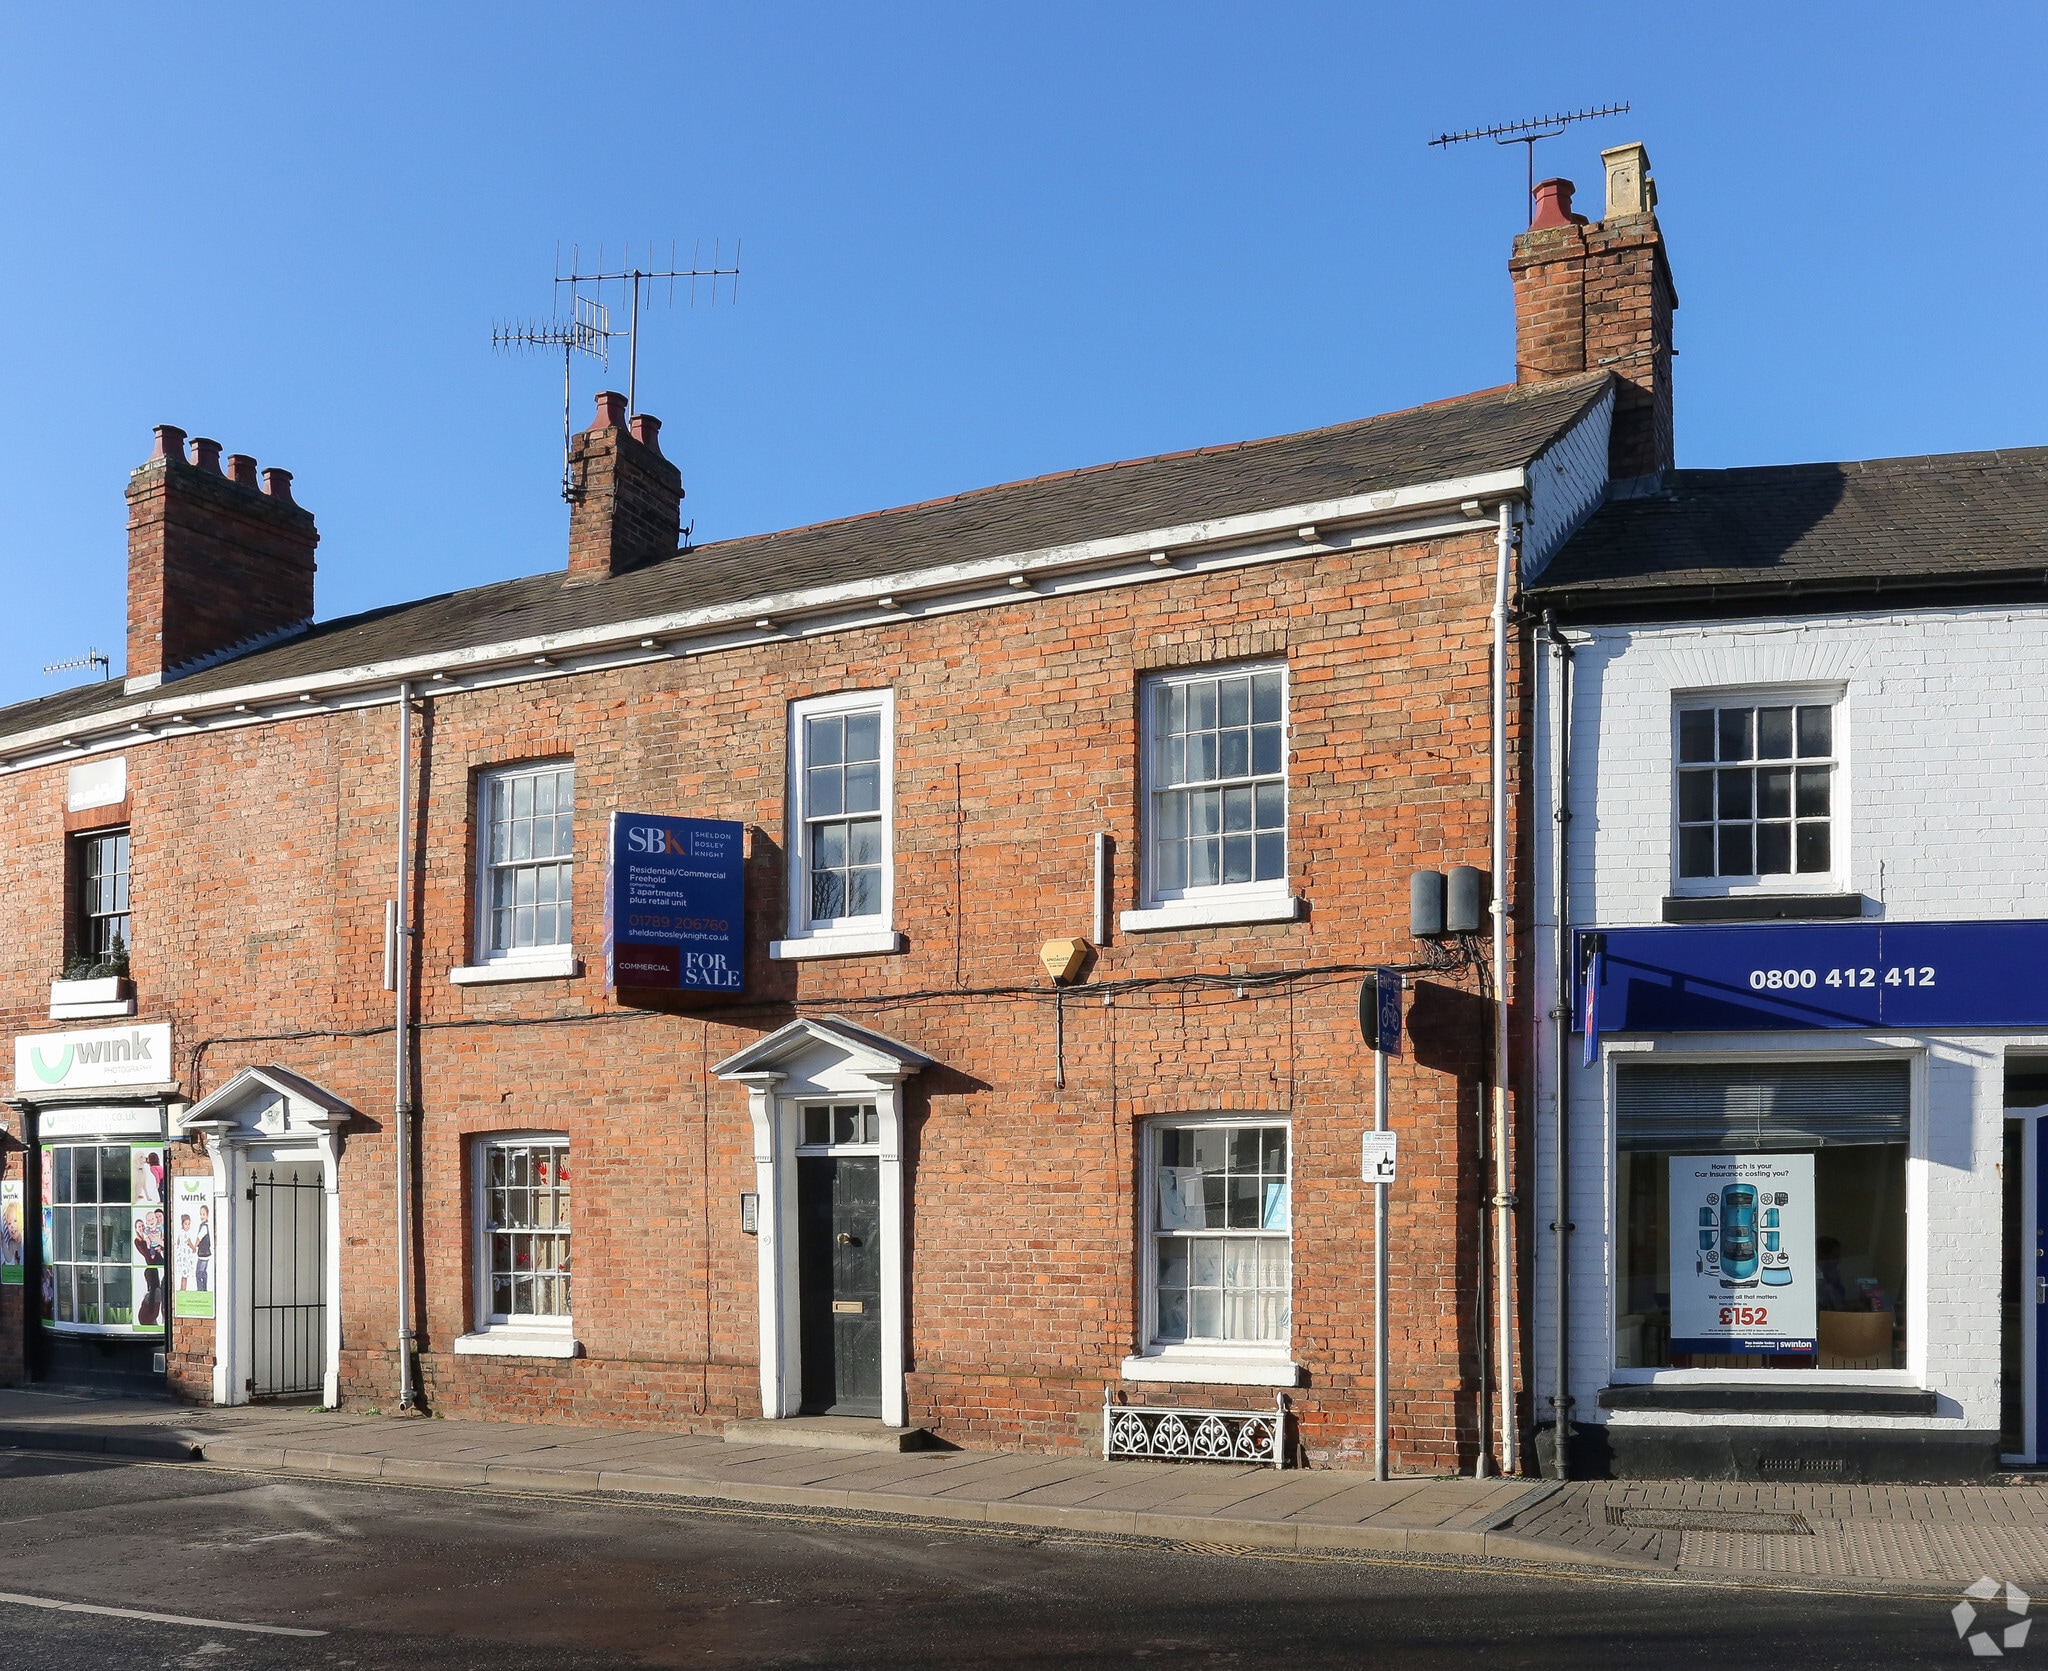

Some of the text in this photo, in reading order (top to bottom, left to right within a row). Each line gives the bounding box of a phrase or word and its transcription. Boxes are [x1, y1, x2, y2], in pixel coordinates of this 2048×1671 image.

[695, 831, 731, 840] SHELDON
[628, 827, 686, 855] SBK
[694, 841, 724, 849] BOSLEY
[630, 866, 726, 880] Residential/Commercial
[630, 875, 666, 884] Freehold
[637, 889, 684, 898] apartments
[630, 897, 687, 907] plus retail unit
[629, 914, 729, 932] 01789 206760
[628, 929, 729, 942] sheldonbosleyknight.co.uk
[685, 952, 727, 970] FOR
[619, 962, 670, 972] COMMERCIAL
[685, 968, 740, 987] SALE
[1749, 967, 1936, 989] 0800 412 412
[76, 1031, 152, 1064] wink
[103, 1065, 152, 1074] PHOTOGRAPHY
[1745, 1171, 1771, 1179] costing
[1772, 1171, 1789, 1179] you?
[3, 1192, 19, 1200] wink
[181, 1191, 207, 1201] wink
[1719, 1307, 1768, 1325] £152
[1780, 1340, 1812, 1348] swinton
